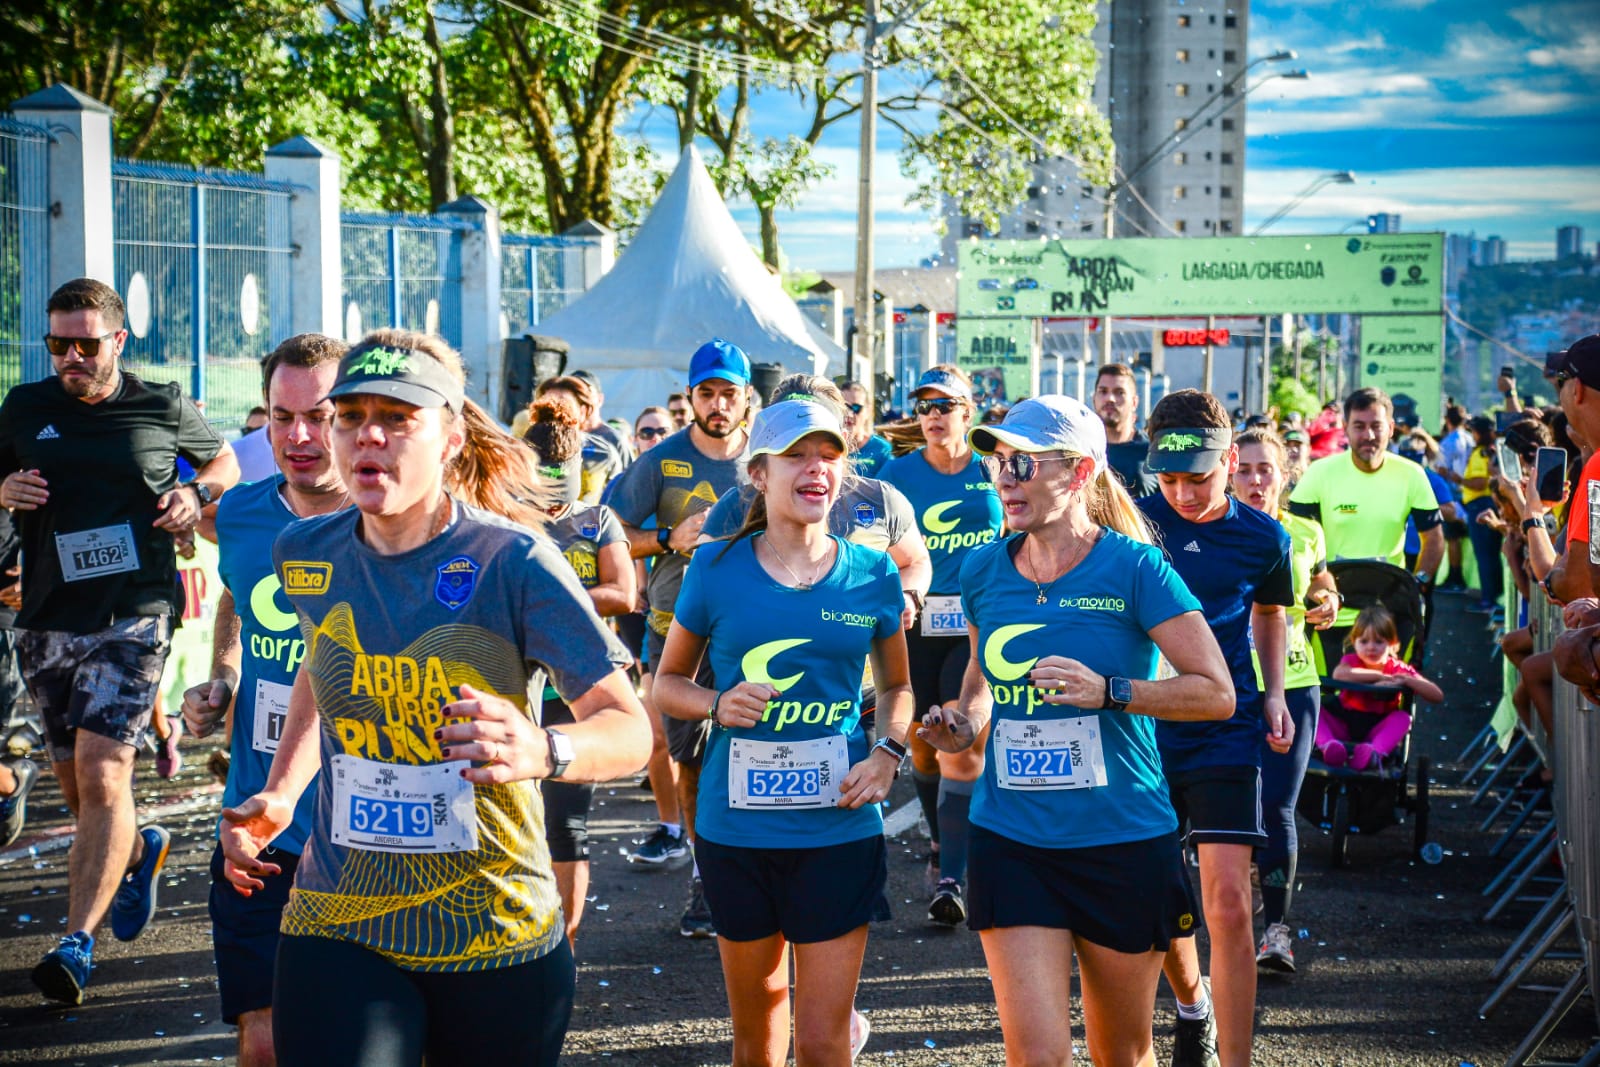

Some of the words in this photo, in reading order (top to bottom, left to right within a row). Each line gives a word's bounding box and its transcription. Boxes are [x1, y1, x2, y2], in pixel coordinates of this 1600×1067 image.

[1067, 256, 1120, 280] ABDA
[1182, 260, 1325, 281] LARGADA/CHEGADA
[1083, 276, 1134, 293] URBAN
[1051, 290, 1108, 313] RUN
[926, 528, 995, 553] orpore
[76, 547, 121, 568] 1462
[1059, 597, 1125, 612] biomoving
[251, 633, 307, 673] corp
[351, 653, 458, 700] ABDA
[761, 700, 852, 731] rpore
[335, 717, 444, 767] RUN
[1069, 739, 1083, 767] 5KM
[819, 759, 831, 787] 5KM
[1010, 750, 1069, 776] 5227
[752, 770, 819, 795] 5228
[353, 799, 431, 835] 5219
[432, 792, 448, 827] 5KM
